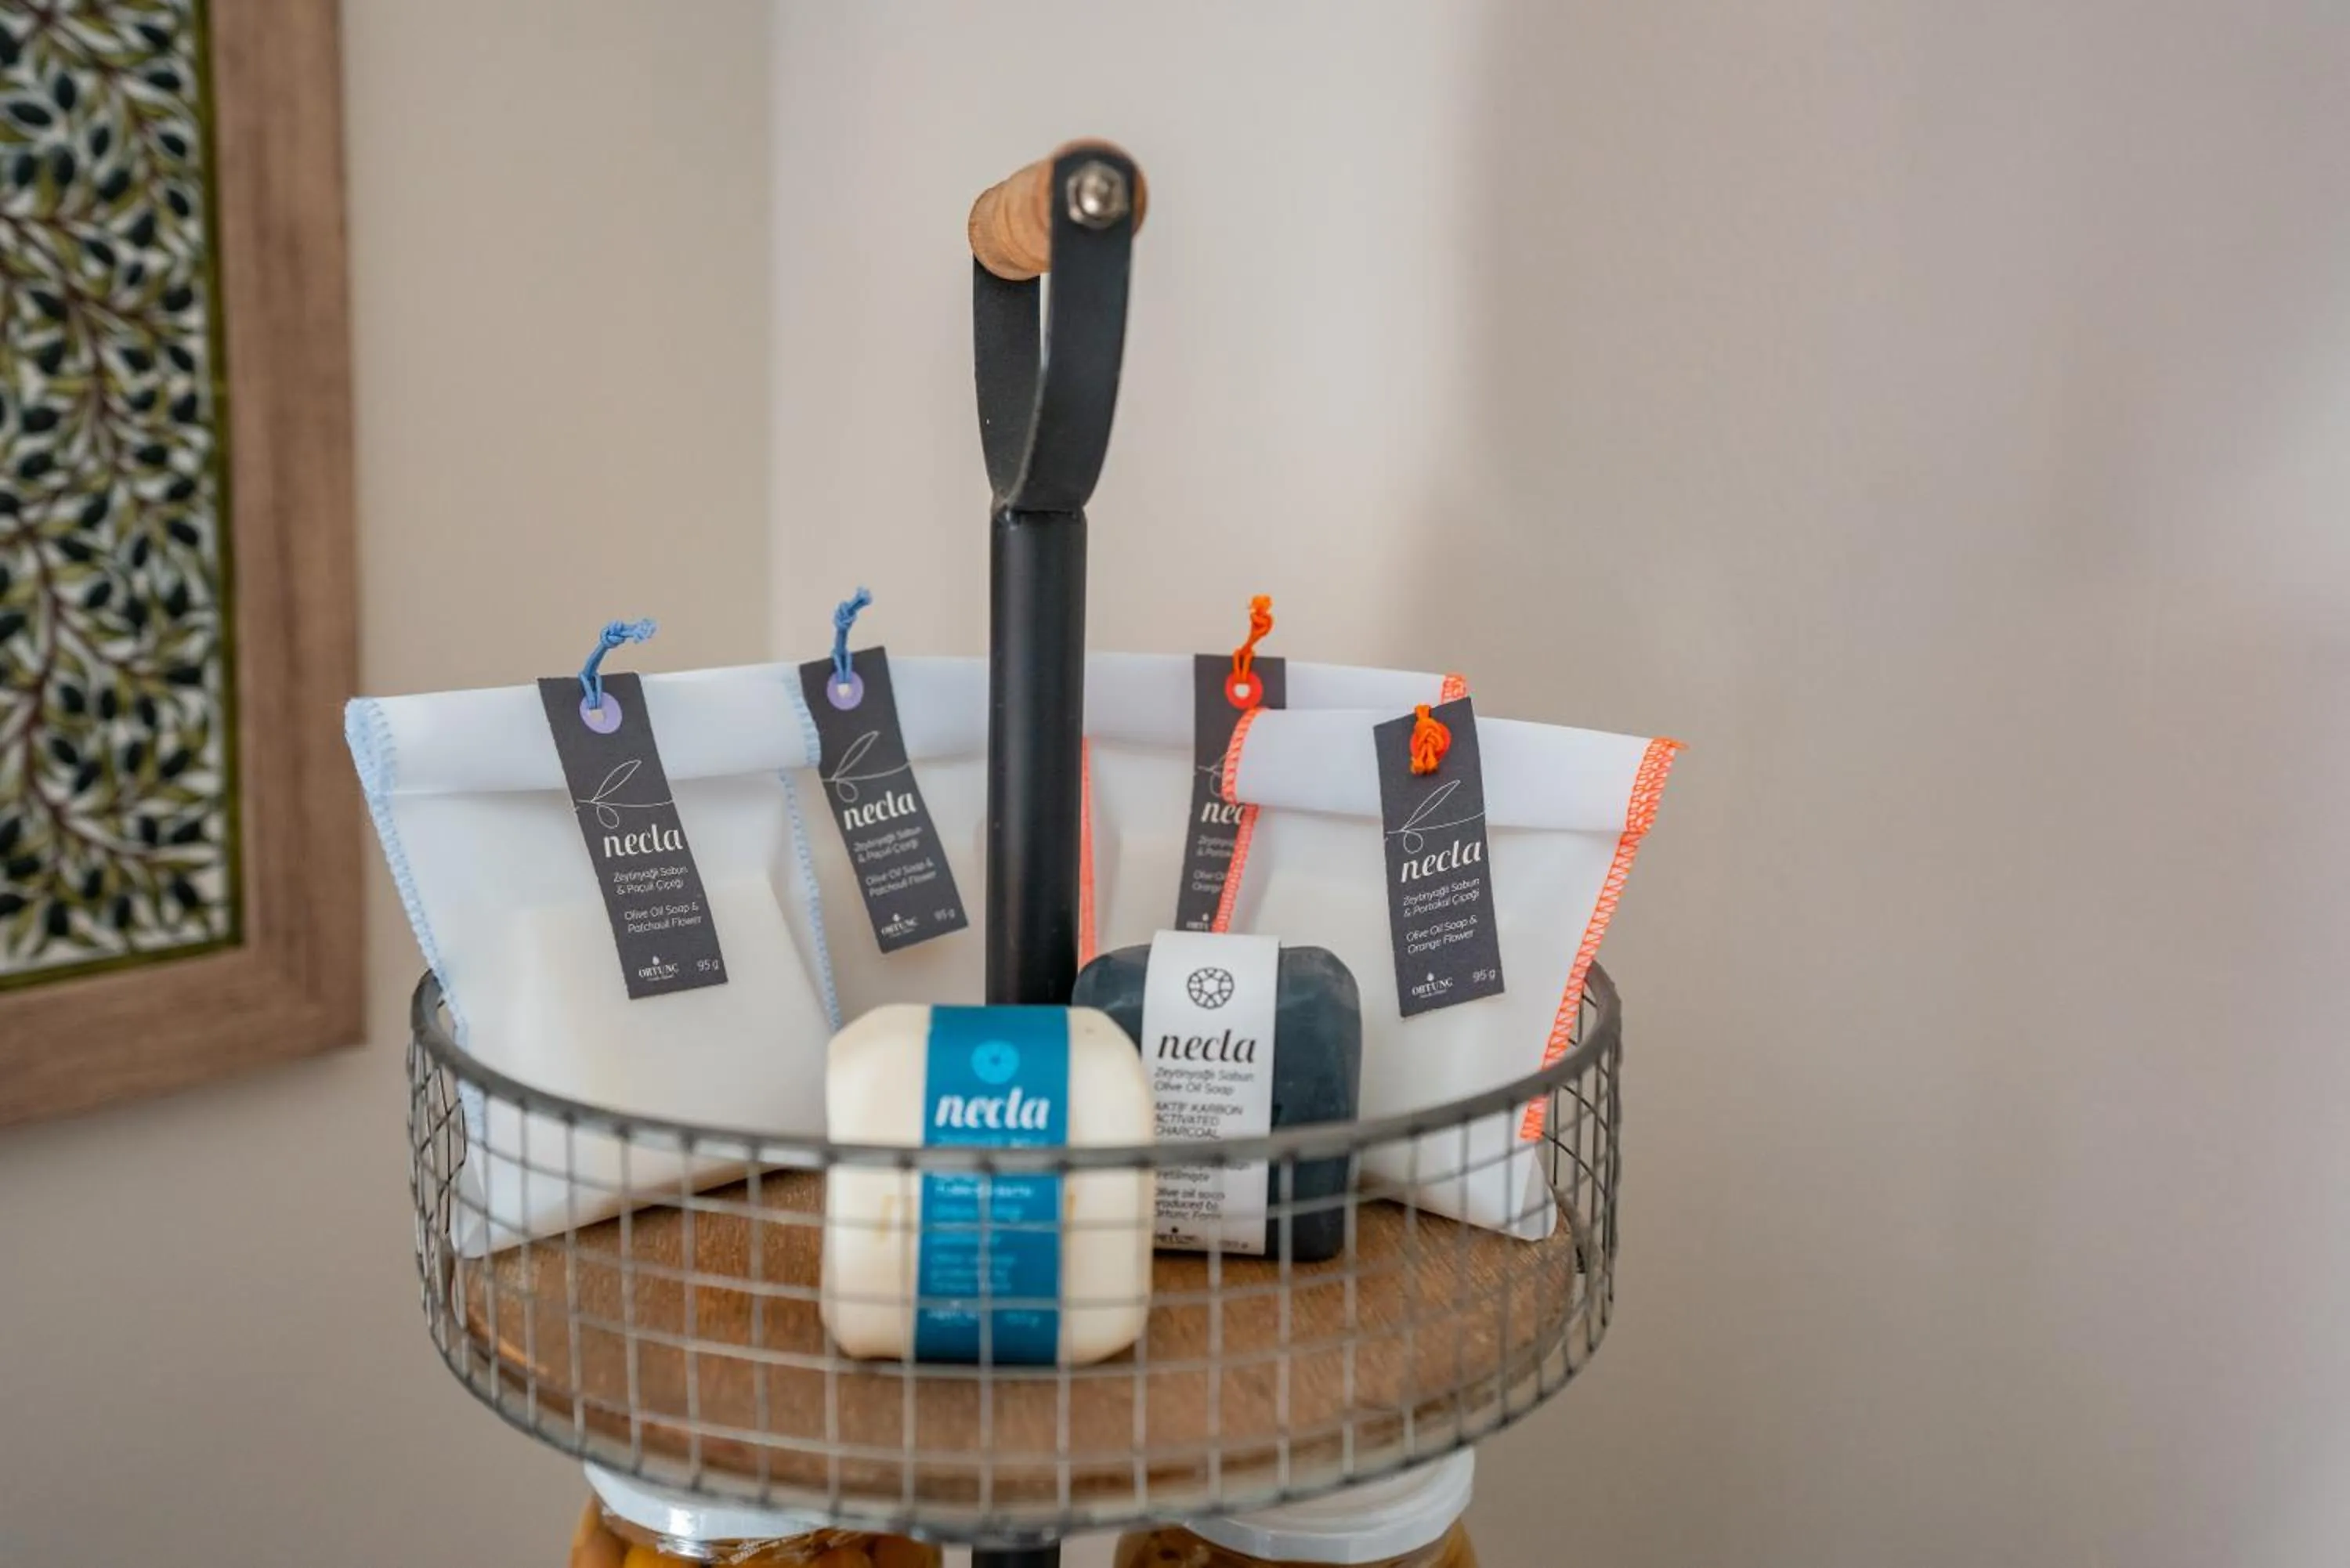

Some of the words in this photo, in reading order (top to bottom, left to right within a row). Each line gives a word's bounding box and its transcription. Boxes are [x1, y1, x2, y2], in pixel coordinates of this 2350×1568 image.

[844, 790, 916, 830] necla
[1201, 802, 1245, 825] nec
[603, 823, 683, 858] necla
[1401, 840, 1480, 883] necla
[665, 904, 690, 915] Soap
[1444, 919, 1470, 932] Soap
[696, 959, 711, 972] 95
[712, 959, 720, 970] g
[1473, 968, 1488, 983] 95
[1488, 969, 1496, 981] g
[1158, 1028, 1256, 1064] necla
[935, 1086, 1051, 1129] necla
